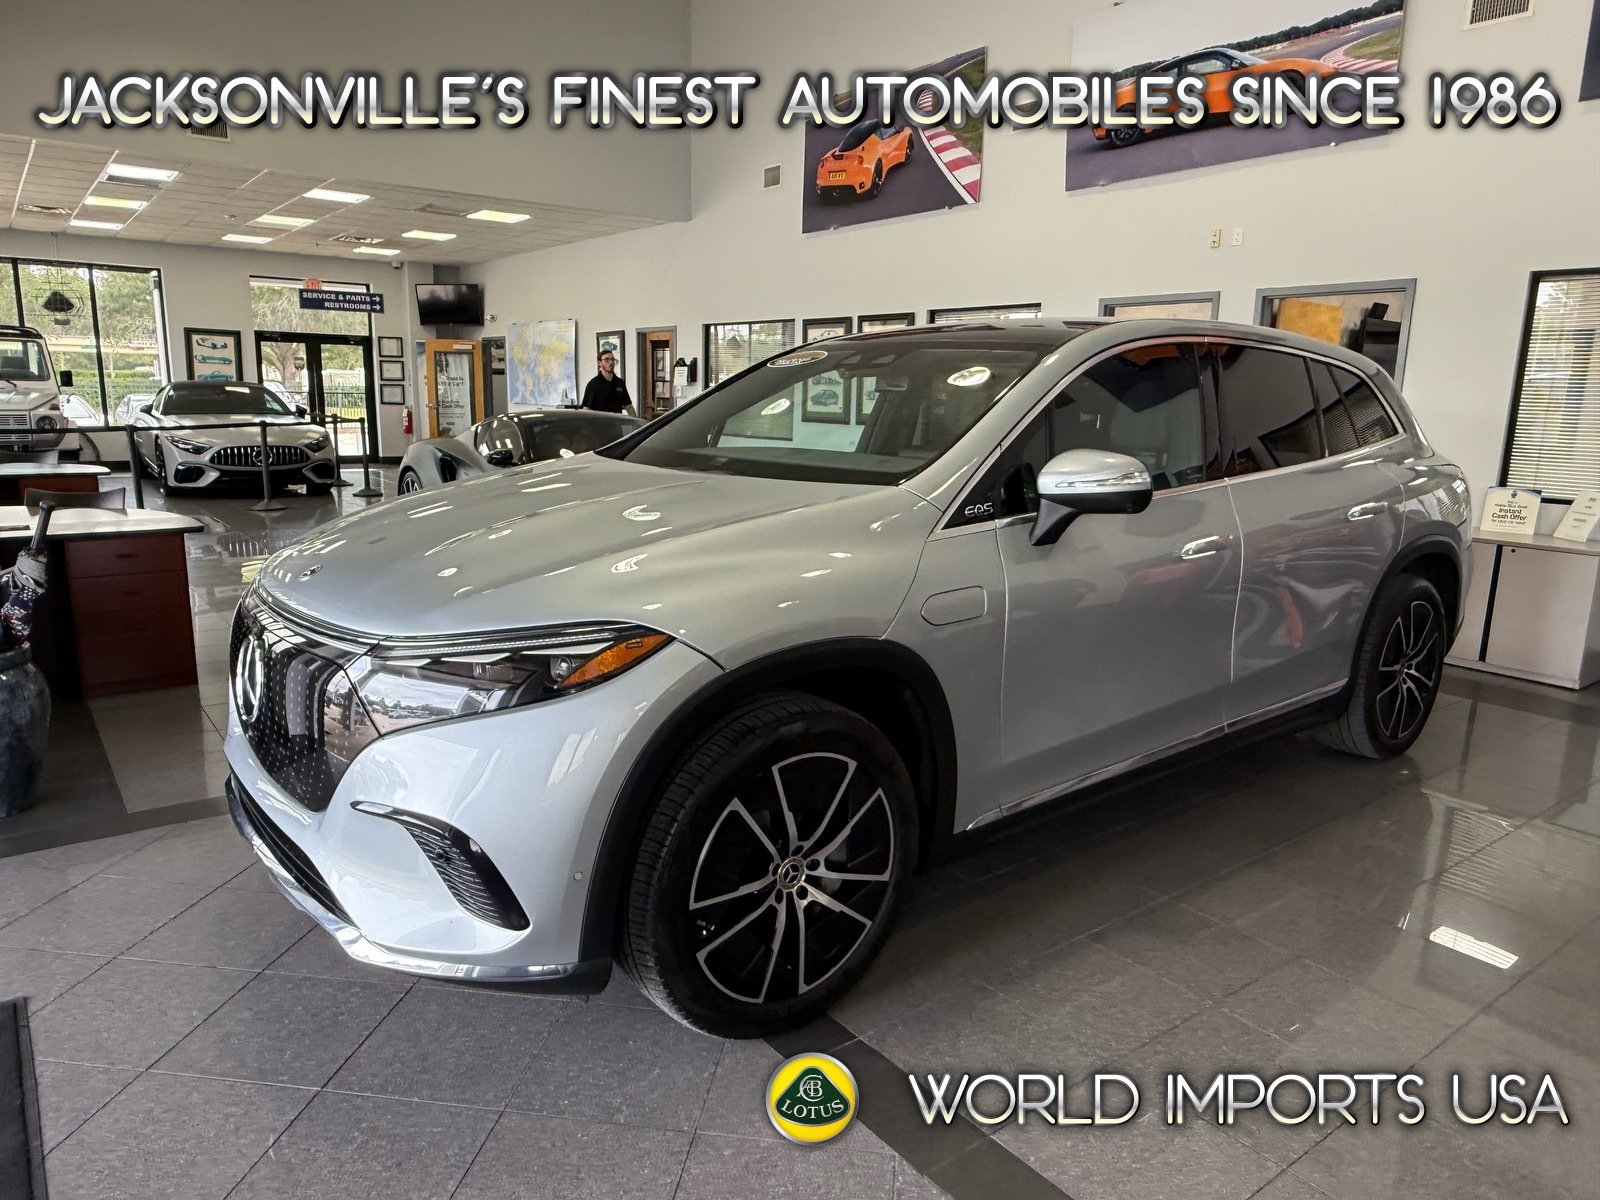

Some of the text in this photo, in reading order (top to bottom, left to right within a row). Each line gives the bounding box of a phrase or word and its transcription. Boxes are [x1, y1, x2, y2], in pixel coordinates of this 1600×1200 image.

[302, 291, 336, 300] SERVICE
[346, 294, 371, 302] PARTS
[324, 301, 371, 310] RESTROOMS
[1492, 512, 1508, 520] Cash
